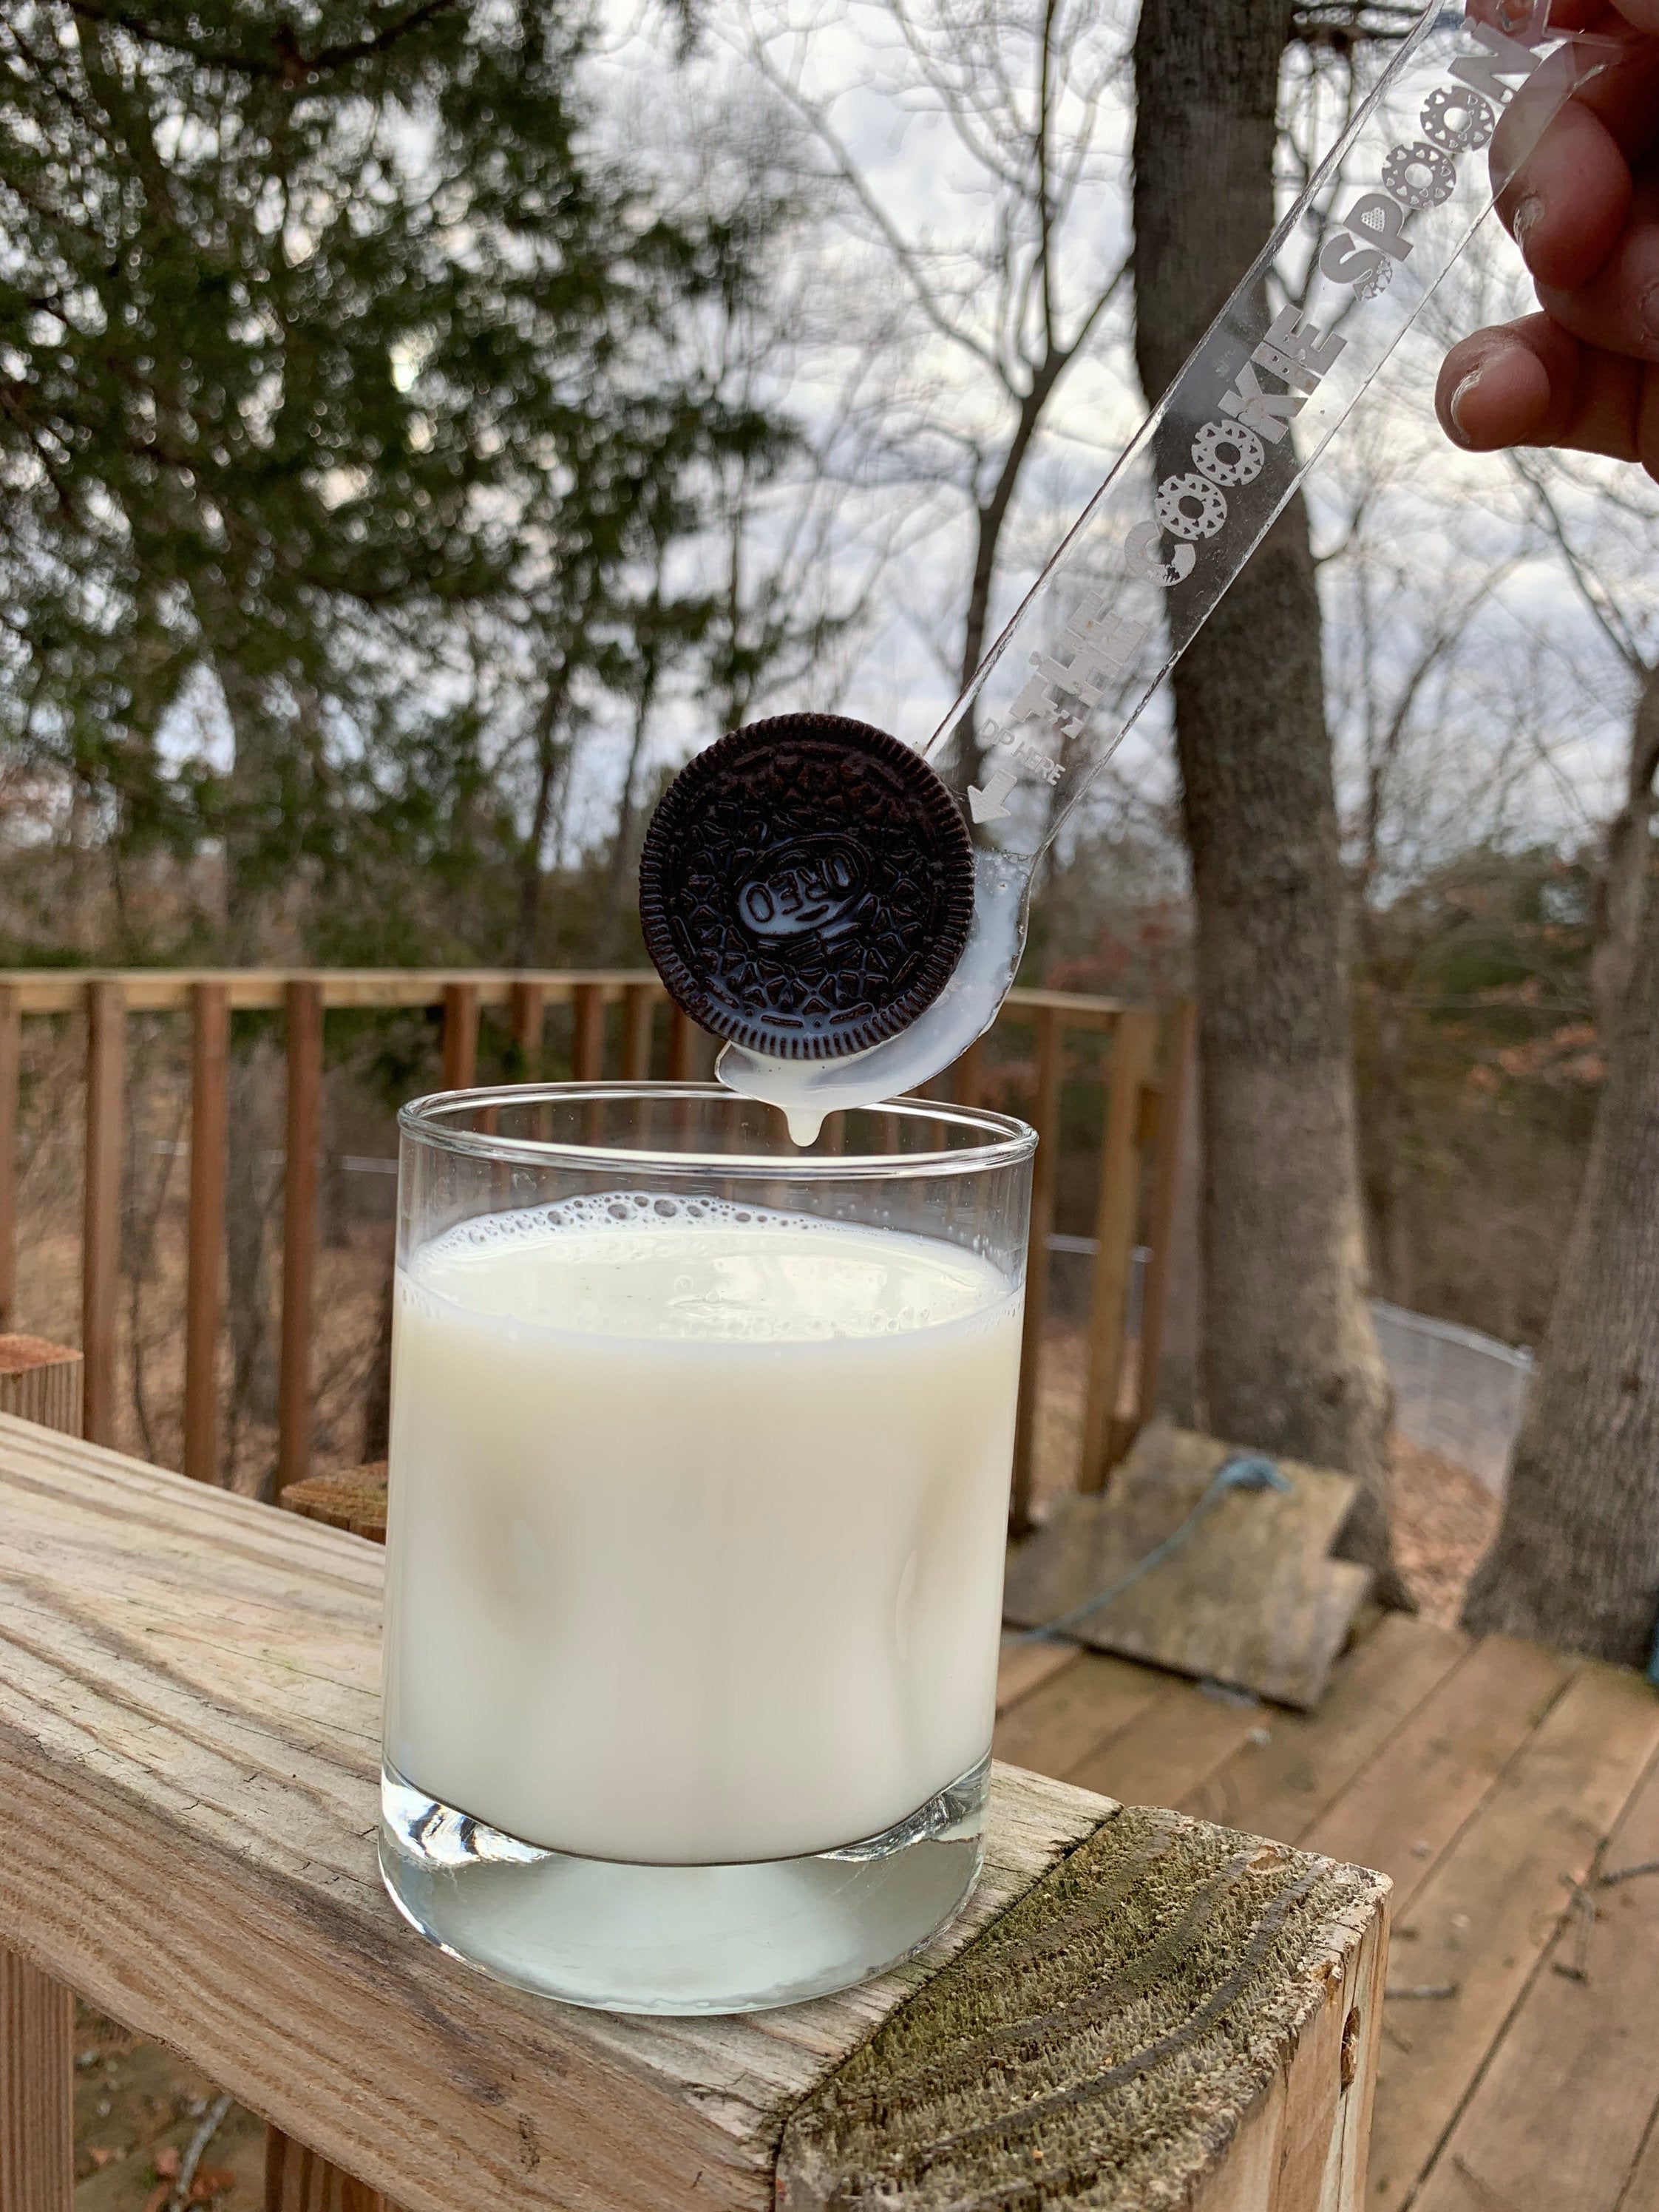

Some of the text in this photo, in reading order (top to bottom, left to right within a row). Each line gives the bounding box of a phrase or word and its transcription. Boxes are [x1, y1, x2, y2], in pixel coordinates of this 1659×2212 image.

[1009, 21, 1544, 739] THE COOKIE SPOON
[978, 717, 1066, 786] DIP HERE
[744, 848, 859, 923] OREO
